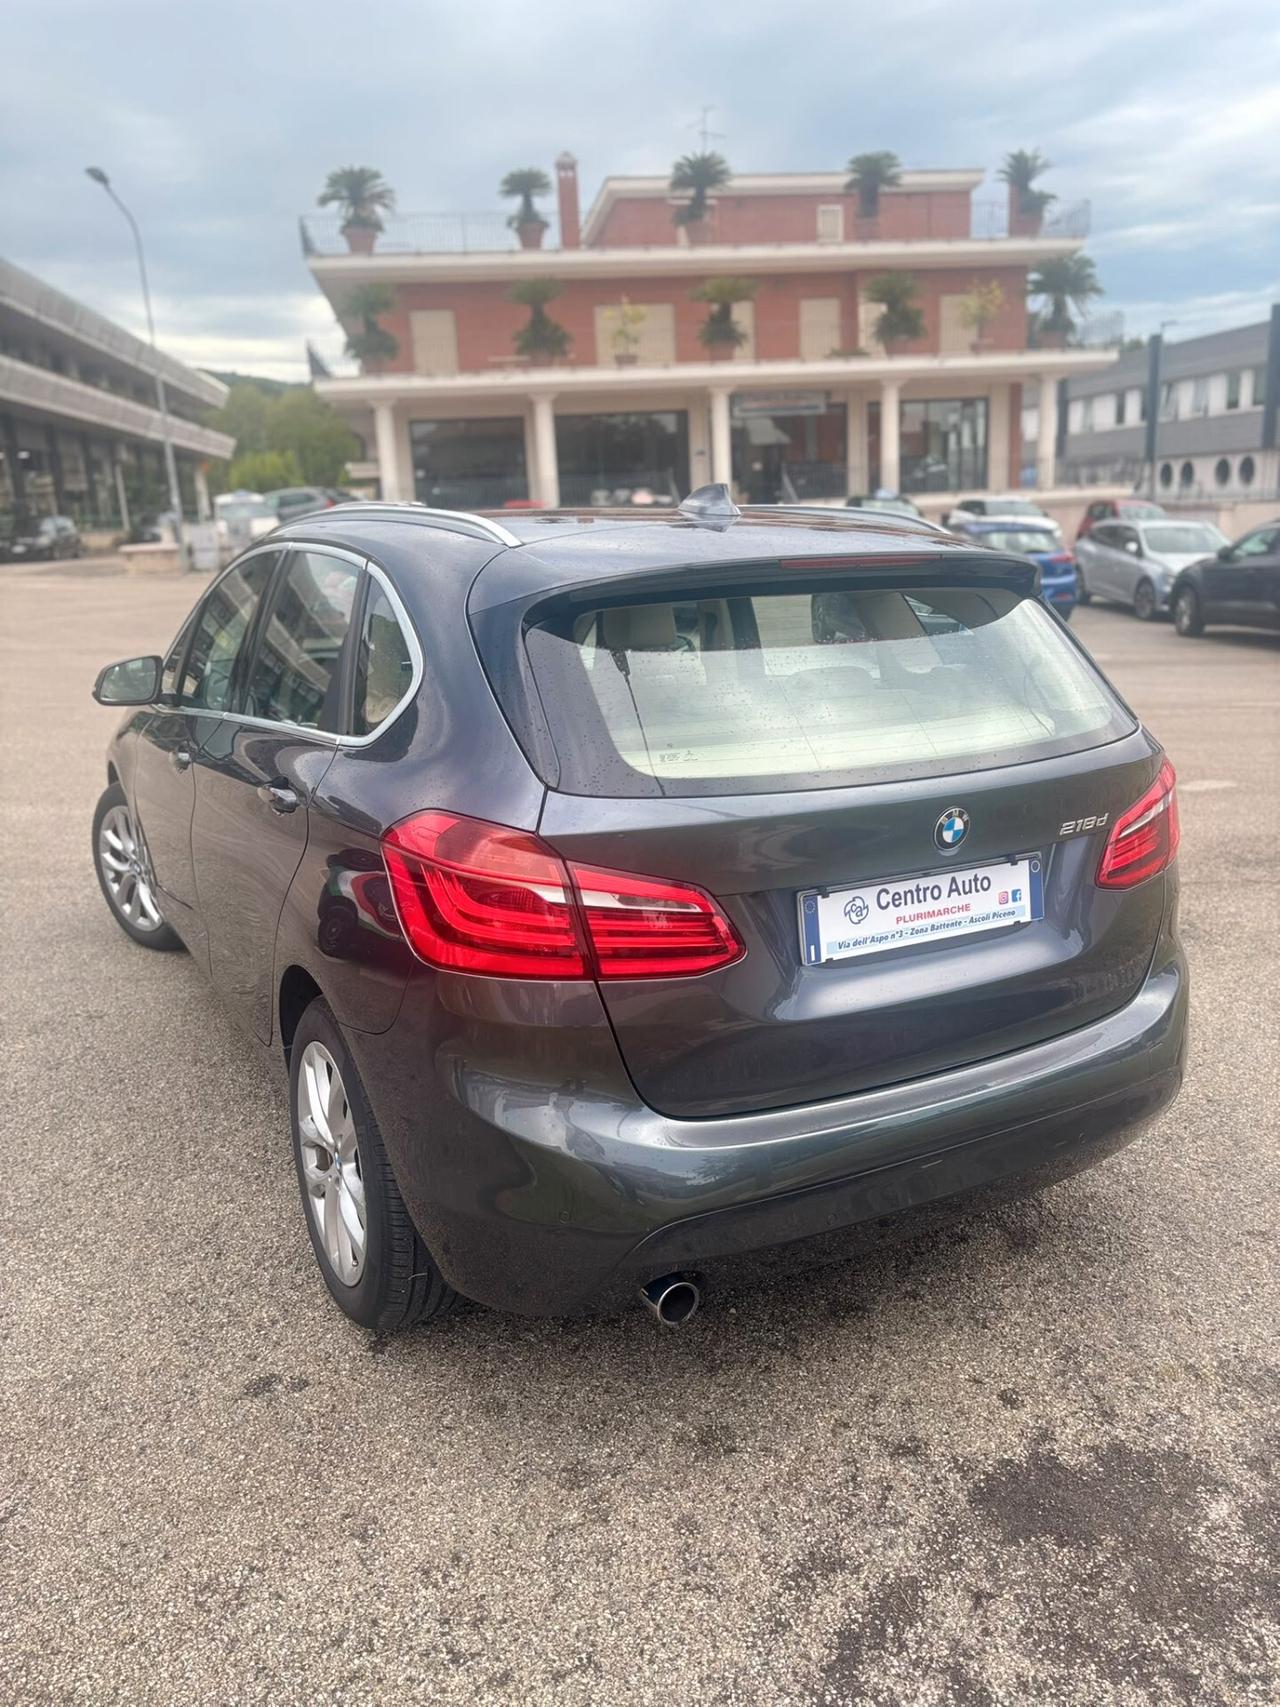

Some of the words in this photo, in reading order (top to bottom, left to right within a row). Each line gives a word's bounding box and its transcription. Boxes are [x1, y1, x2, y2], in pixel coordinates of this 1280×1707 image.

[1060, 813, 1109, 835] 218d
[876, 883, 942, 910] Centro
[947, 873, 991, 898] Auto
[896, 903, 971, 924] PLURIMARCHE
[838, 941, 850, 950] Via
[852, 934, 889, 947] dell'Aspo
[910, 927, 928, 936] Zona
[930, 920, 962, 932] Battente
[968, 914, 990, 925] Ascoli
[992, 909, 1015, 920] Piceno
